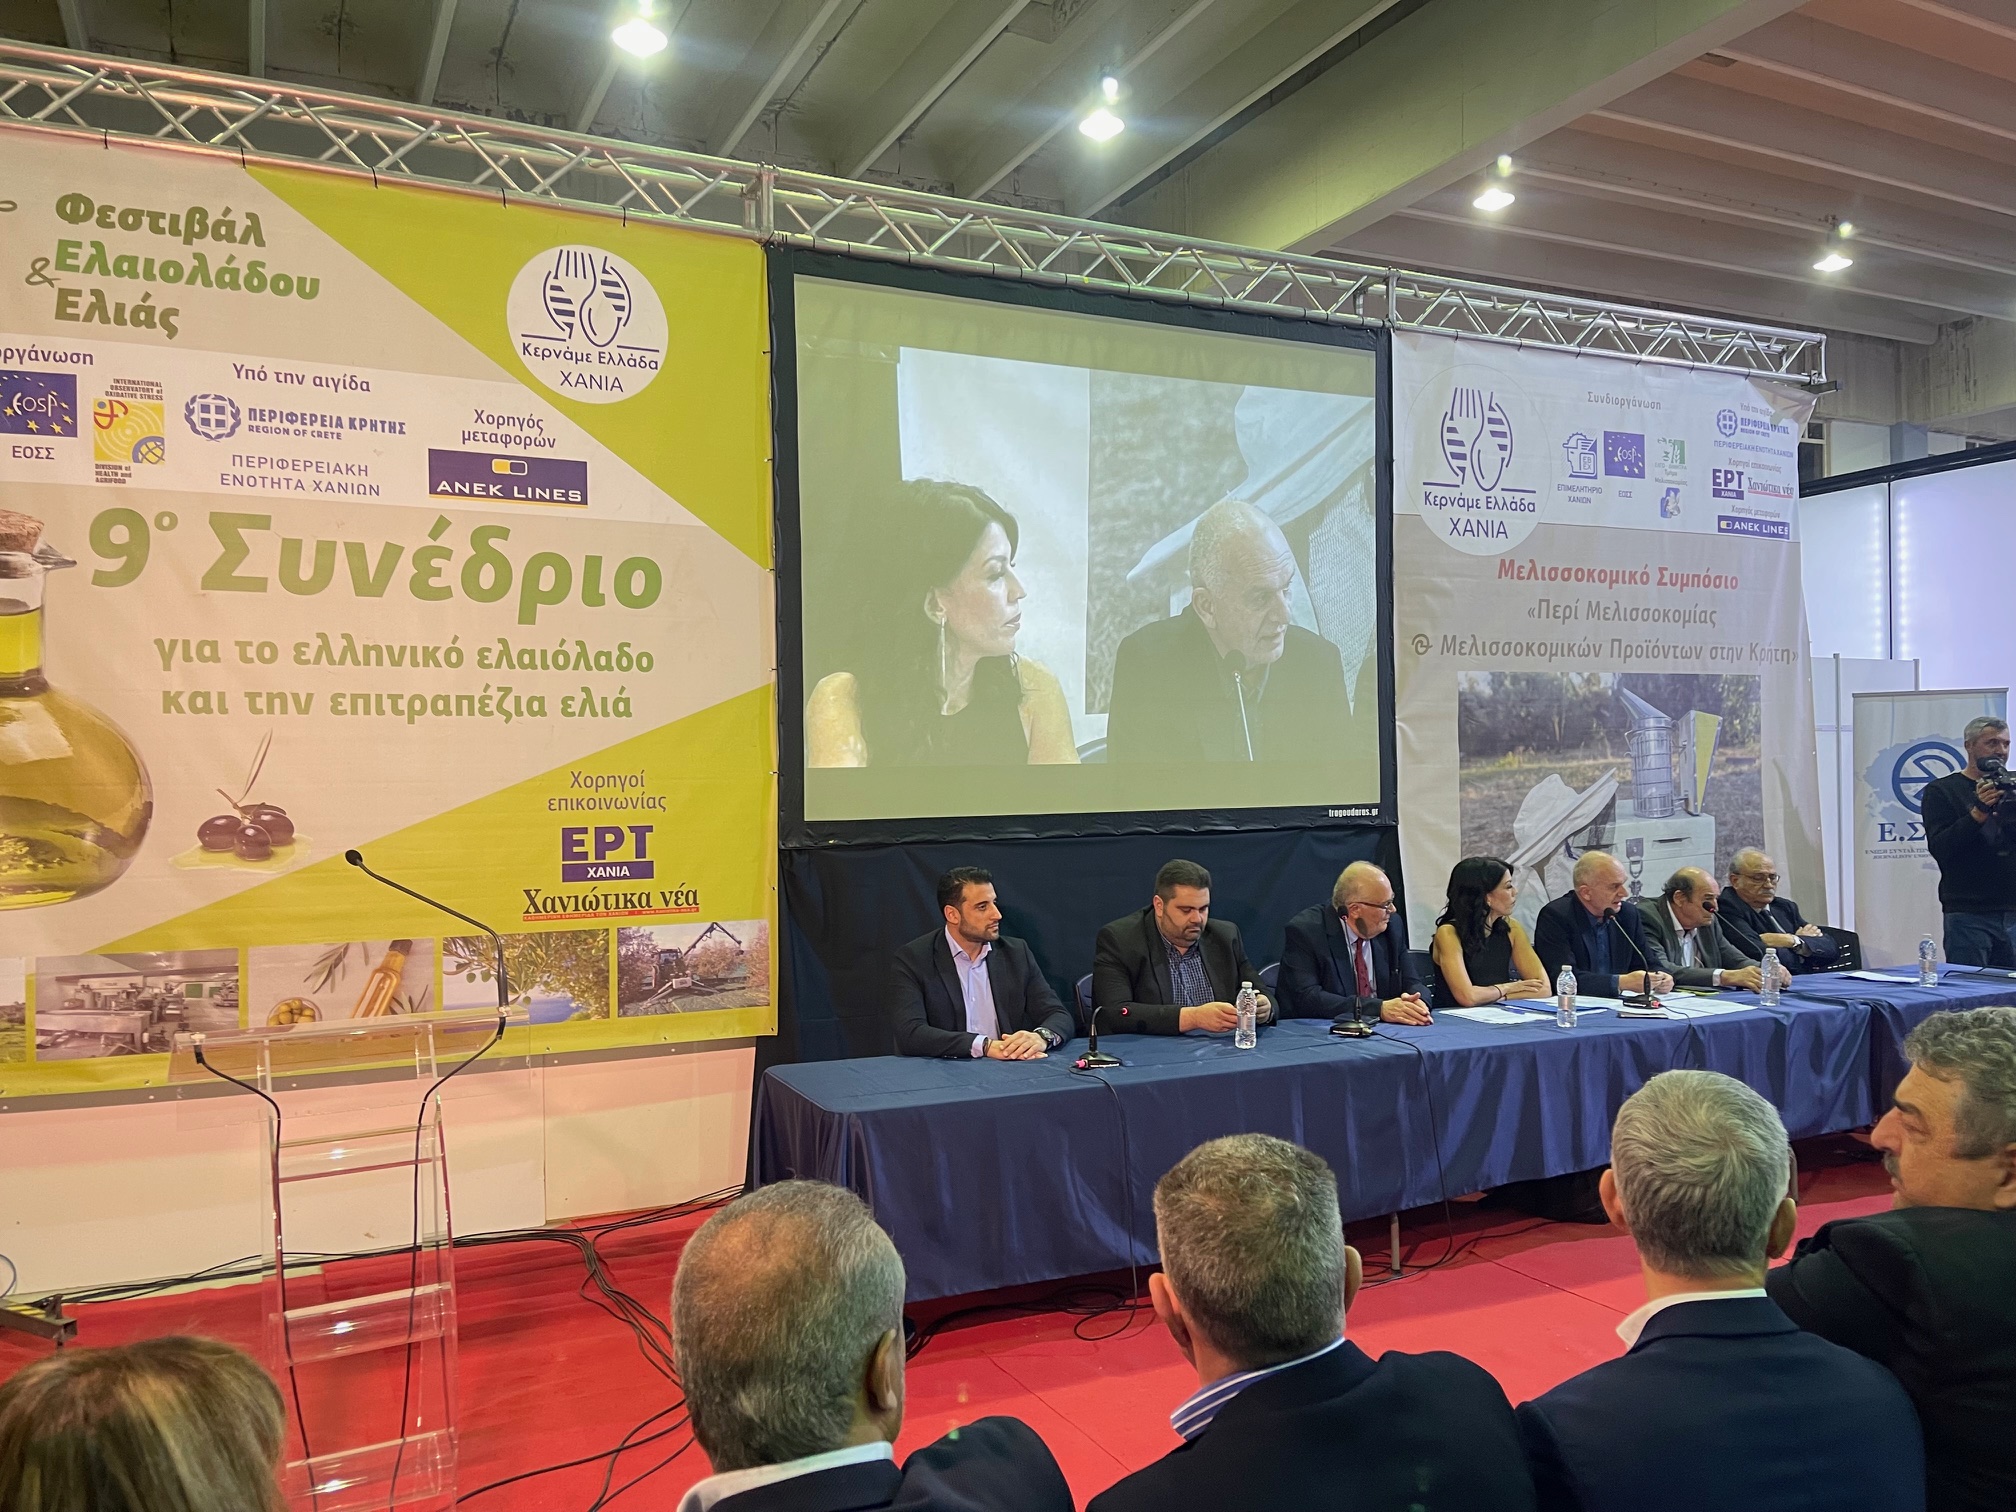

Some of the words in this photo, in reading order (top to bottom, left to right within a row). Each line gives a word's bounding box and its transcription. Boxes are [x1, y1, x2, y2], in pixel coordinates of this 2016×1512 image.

[55, 192, 267, 247] Φεστιβάλ
[25, 256, 61, 288] &
[54, 238, 320, 300] Ελαιολάδου
[54, 287, 180, 340] Ελιάς
[0, 344, 94, 365] ργάνωση
[522, 342, 592, 365] Κερνάμε
[598, 351, 659, 371] Ελλάδα
[110, 384, 154, 394] OBSERVATORY
[113, 378, 163, 388] INTERNATIONAL
[232, 363, 268, 383] Υπό
[274, 370, 307, 386] την
[312, 372, 371, 393] αιγίδα
[560, 370, 624, 392] ΧΑΝΙΑ
[105, 390, 138, 399] OXIDATIVE
[139, 393, 163, 401] STRESS
[1588, 391, 1661, 410] Συνδιοργάνωση
[248, 407, 343, 430] ΠΕΡΙΦΕΡΕΙΑ
[348, 417, 406, 435] ΚΡΗΤΗΣ
[248, 424, 290, 436] REGION
[293, 428, 308, 437] OF
[311, 429, 342, 440] CRETE
[474, 409, 544, 436] Χορηγός
[461, 428, 556, 449] μεταφορών
[1714, 440, 1755, 451] ΠΕΡΙΦΕΡΕΙΑΚΗ
[12, 445, 55, 460] ΕΟΣΣ
[95, 463, 122, 471] DIVISION
[95, 470, 118, 478] HEALTH
[232, 454, 369, 477] ΠΕΡΙΦΕΡΕΙΑΚΗ
[220, 473, 305, 491] ΕΝΟΤΗΤΑ
[313, 479, 381, 496] ΧΑΝΙΩΝ
[1557, 484, 1602, 494] ΕΠΙΜΕΛΗΤΗΡΙΟ
[1712, 468, 1744, 489] ΕΡΤ
[436, 480, 504, 497] ANEK
[513, 485, 582, 502] LINES
[1424, 491, 1481, 511] Κερνάμε
[1485, 495, 1536, 513] Ελλάδα
[1449, 518, 1508, 539] ΧΑΝΙΑ
[1733, 522, 1759, 532] ANEK
[1763, 524, 1788, 535] LINES
[200, 514, 662, 625] Συνέδριο
[1498, 558, 1650, 586] Μελισσοκομικό
[1657, 566, 1739, 593] Συμπόσιο
[1527, 598, 1579, 623] «Περί
[1586, 600, 1717, 628] Μελισσοκομίας
[154, 634, 221, 671] για
[234, 639, 279, 664] το
[293, 633, 464, 670] ελληνικό
[477, 638, 654, 673] ελαιόλαδο
[1440, 634, 1601, 661] Μελισσοκομικών
[1610, 638, 1703, 664] Προϊόντων
[1709, 643, 1744, 663] στην
[162, 689, 228, 714] και
[245, 688, 315, 715] την
[329, 684, 547, 724] επιτραπέζια
[559, 684, 632, 718] ελιά
[570, 770, 645, 792] Χορηγοί
[548, 791, 667, 812] επικοινωνίας
[562, 825, 654, 861] ΕΡΤ
[587, 866, 630, 878] ΧΑΝΙΑ
[523, 886, 652, 914] Χανιώτικα
[660, 883, 699, 907] νέα
